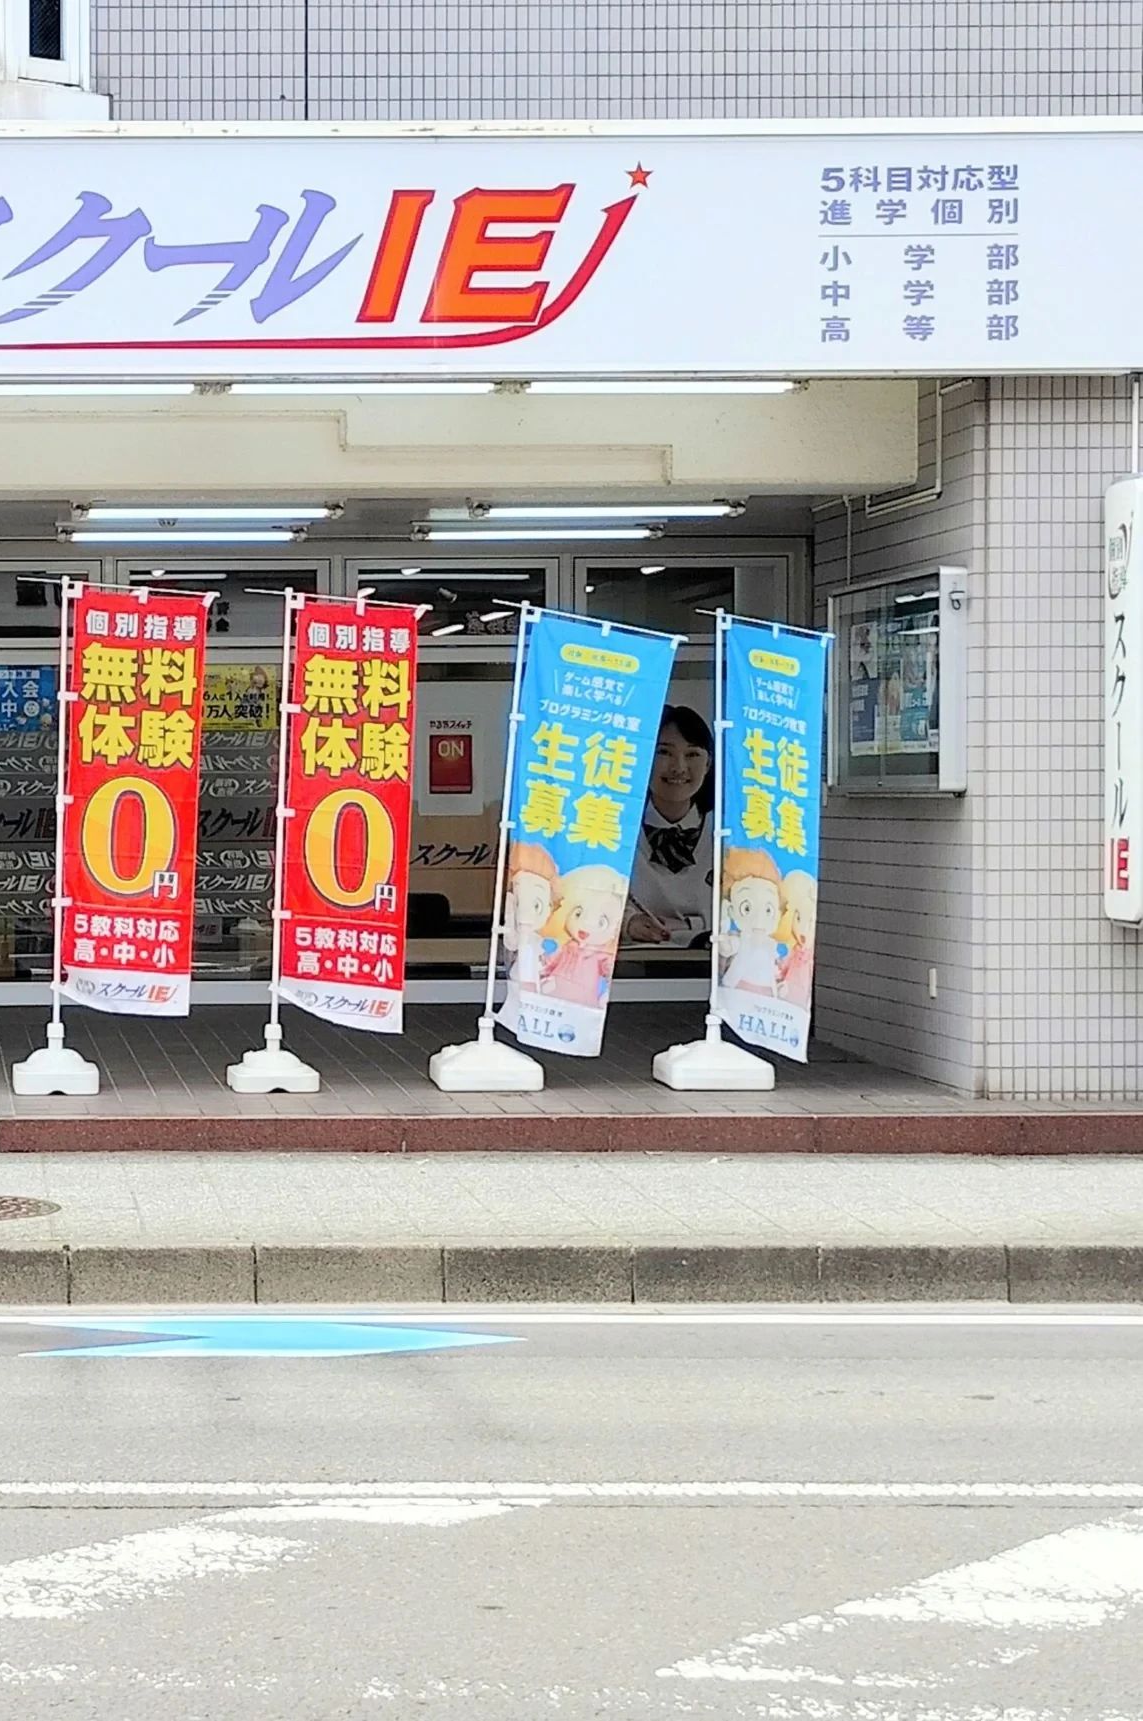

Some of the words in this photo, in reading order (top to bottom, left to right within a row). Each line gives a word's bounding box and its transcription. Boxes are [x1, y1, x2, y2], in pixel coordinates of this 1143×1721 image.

[820, 164, 1019, 193] 5科目対応型
[819, 198, 1019, 226] 進学個別
[819, 244, 1019, 271] 小学部
[819, 279, 1019, 306] 中学部
[819, 314, 1019, 342] 高等部
[86, 610, 197, 641] 個別指導
[308, 621, 410, 653] 個別指導
[81, 642, 197, 706] 無料
[302, 654, 411, 719] 無料
[78, 704, 195, 769] 体験
[300, 717, 410, 783] 体験
[438, 741, 464, 757] ON
[527, 722, 637, 794] 生徒
[742, 727, 809, 798] 生徒
[519, 779, 624, 852] 募集
[741, 784, 807, 857] 募集
[74, 913, 180, 942] 5教科対応
[295, 927, 397, 956] 5教科対応
[74, 937, 175, 968] 高・中・小
[297, 951, 393, 983] 高・中・小
